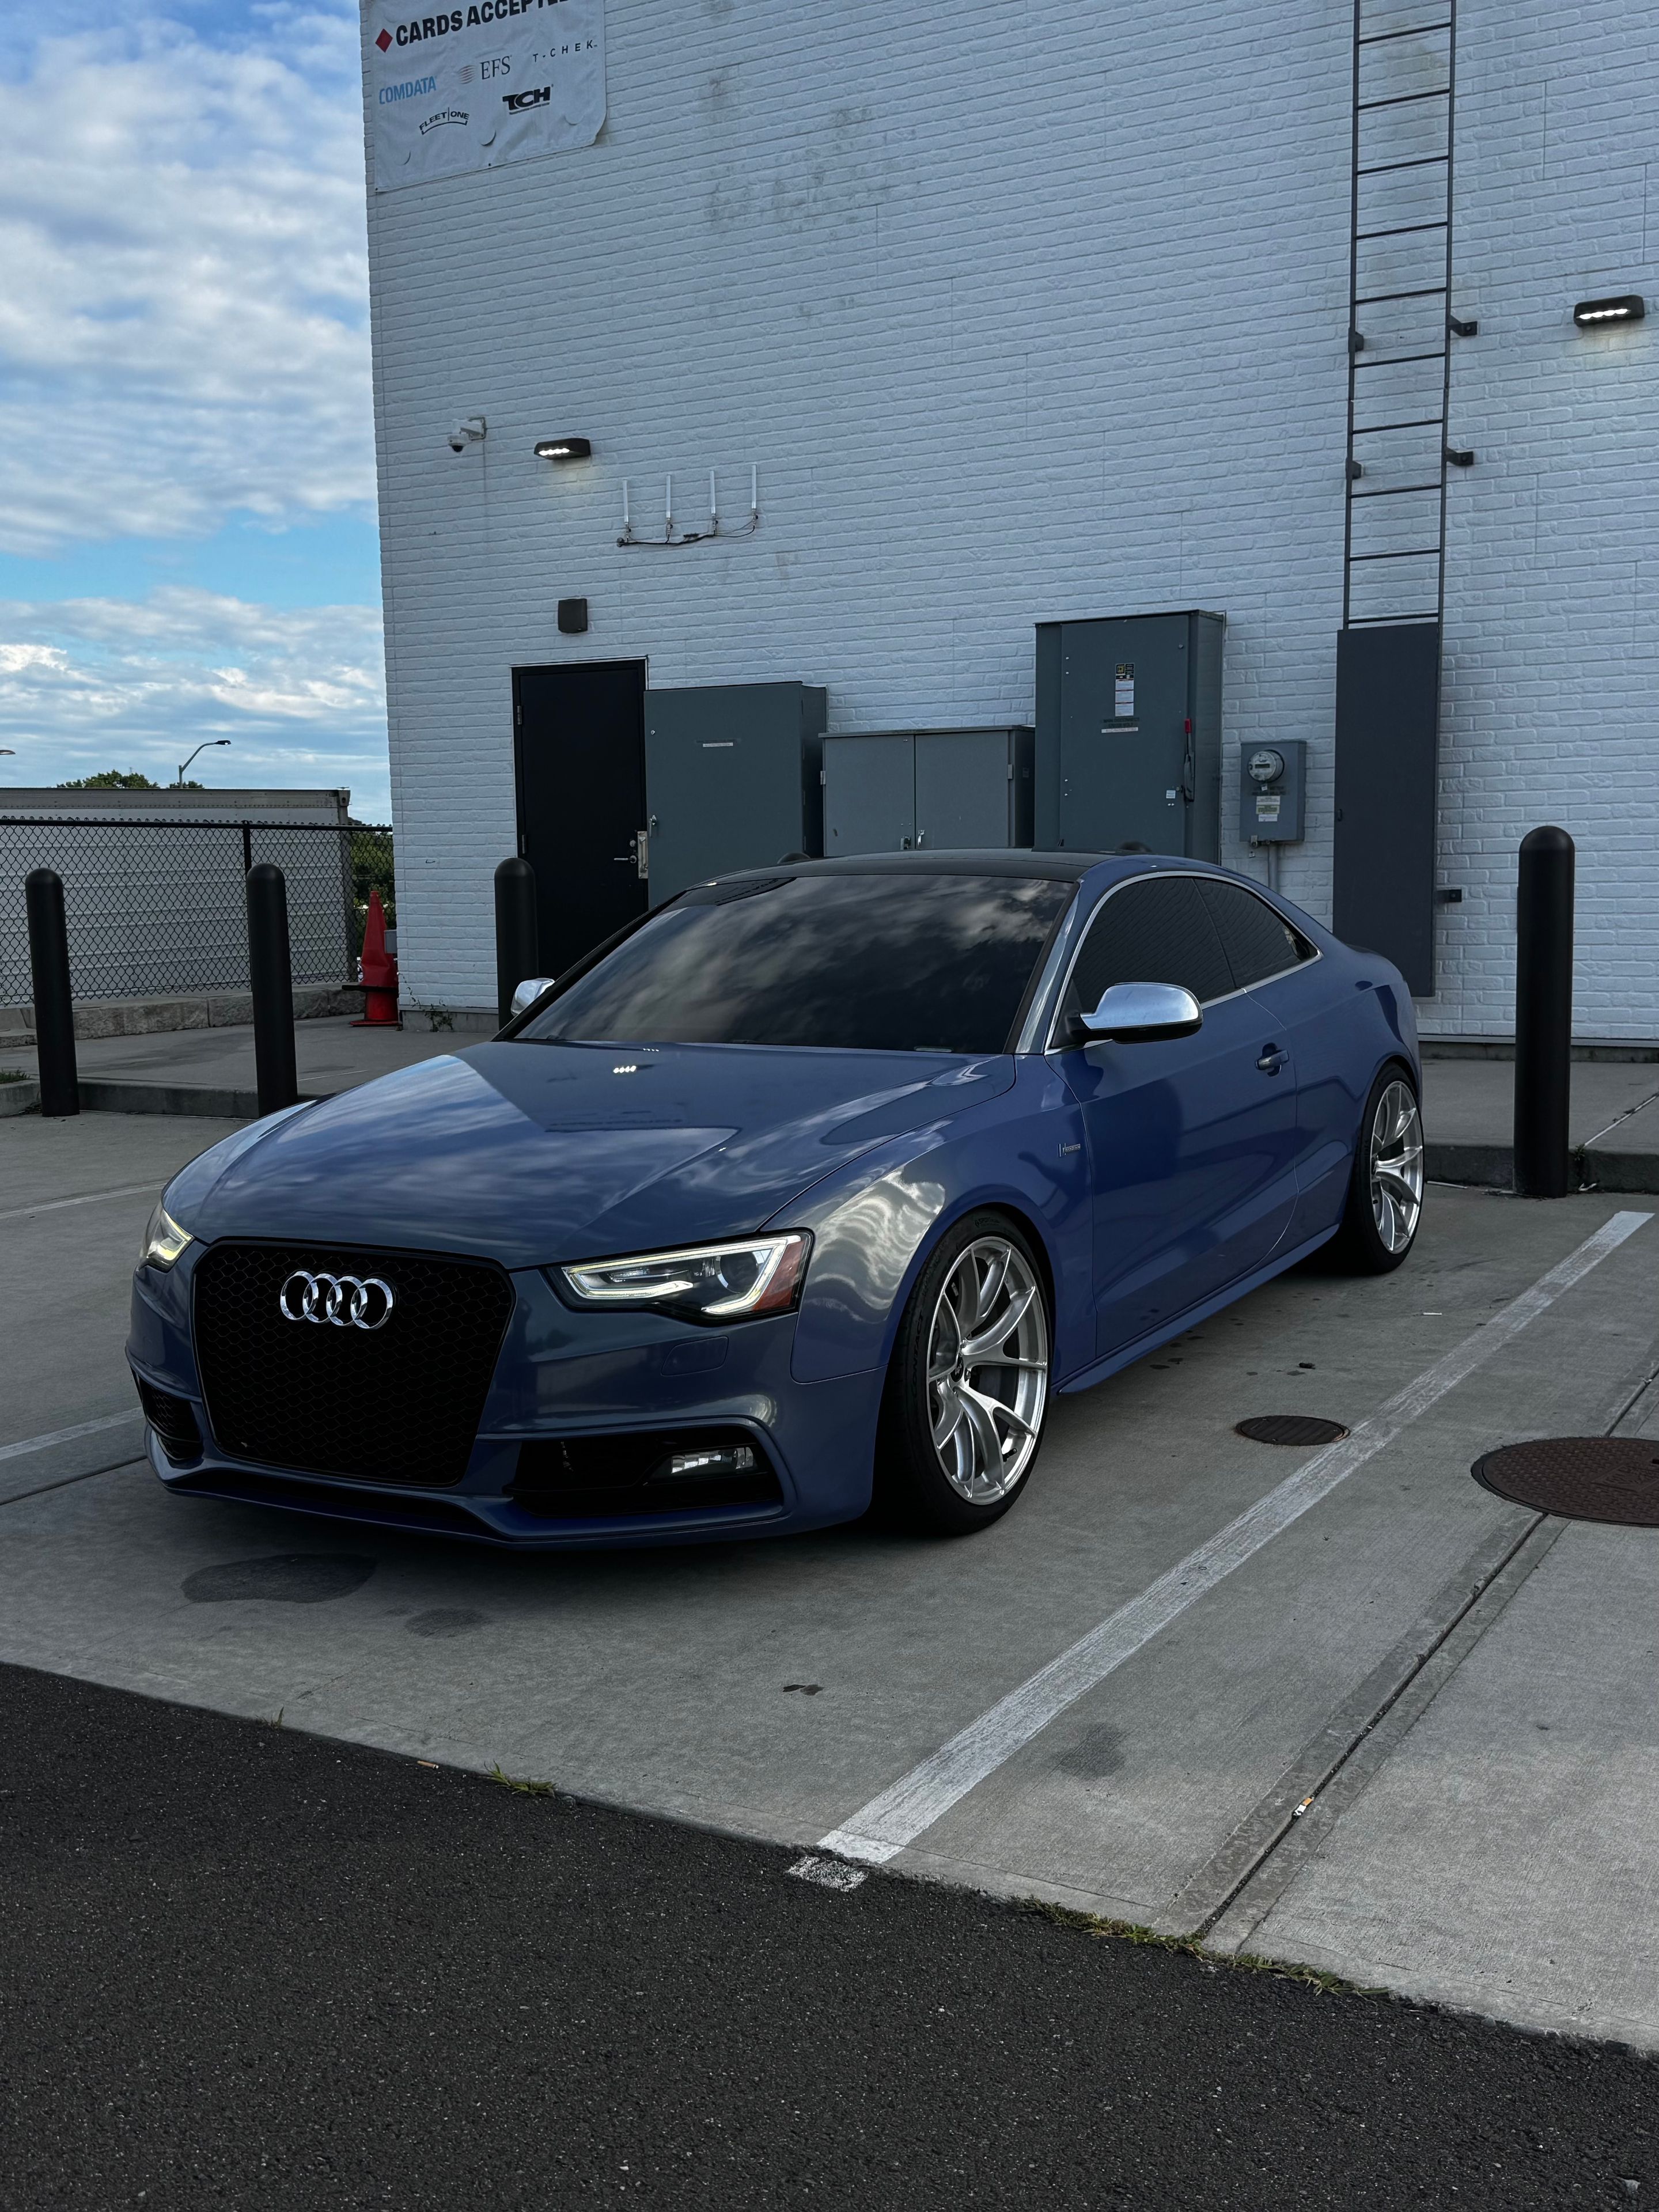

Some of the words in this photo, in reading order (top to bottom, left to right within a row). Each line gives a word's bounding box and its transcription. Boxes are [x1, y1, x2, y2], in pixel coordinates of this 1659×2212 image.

[396, 10, 463, 47] CARDS
[467, 0, 569, 27] ACCEP
[533, 40, 593, 62] T-CHEK
[480, 56, 510, 79] EFS
[379, 75, 436, 104] COMDATA
[502, 86, 551, 111] TCH
[419, 111, 447, 130] FLEET
[450, 111, 469, 120] ONE
[911, 1310, 923, 1399] CONTACT
